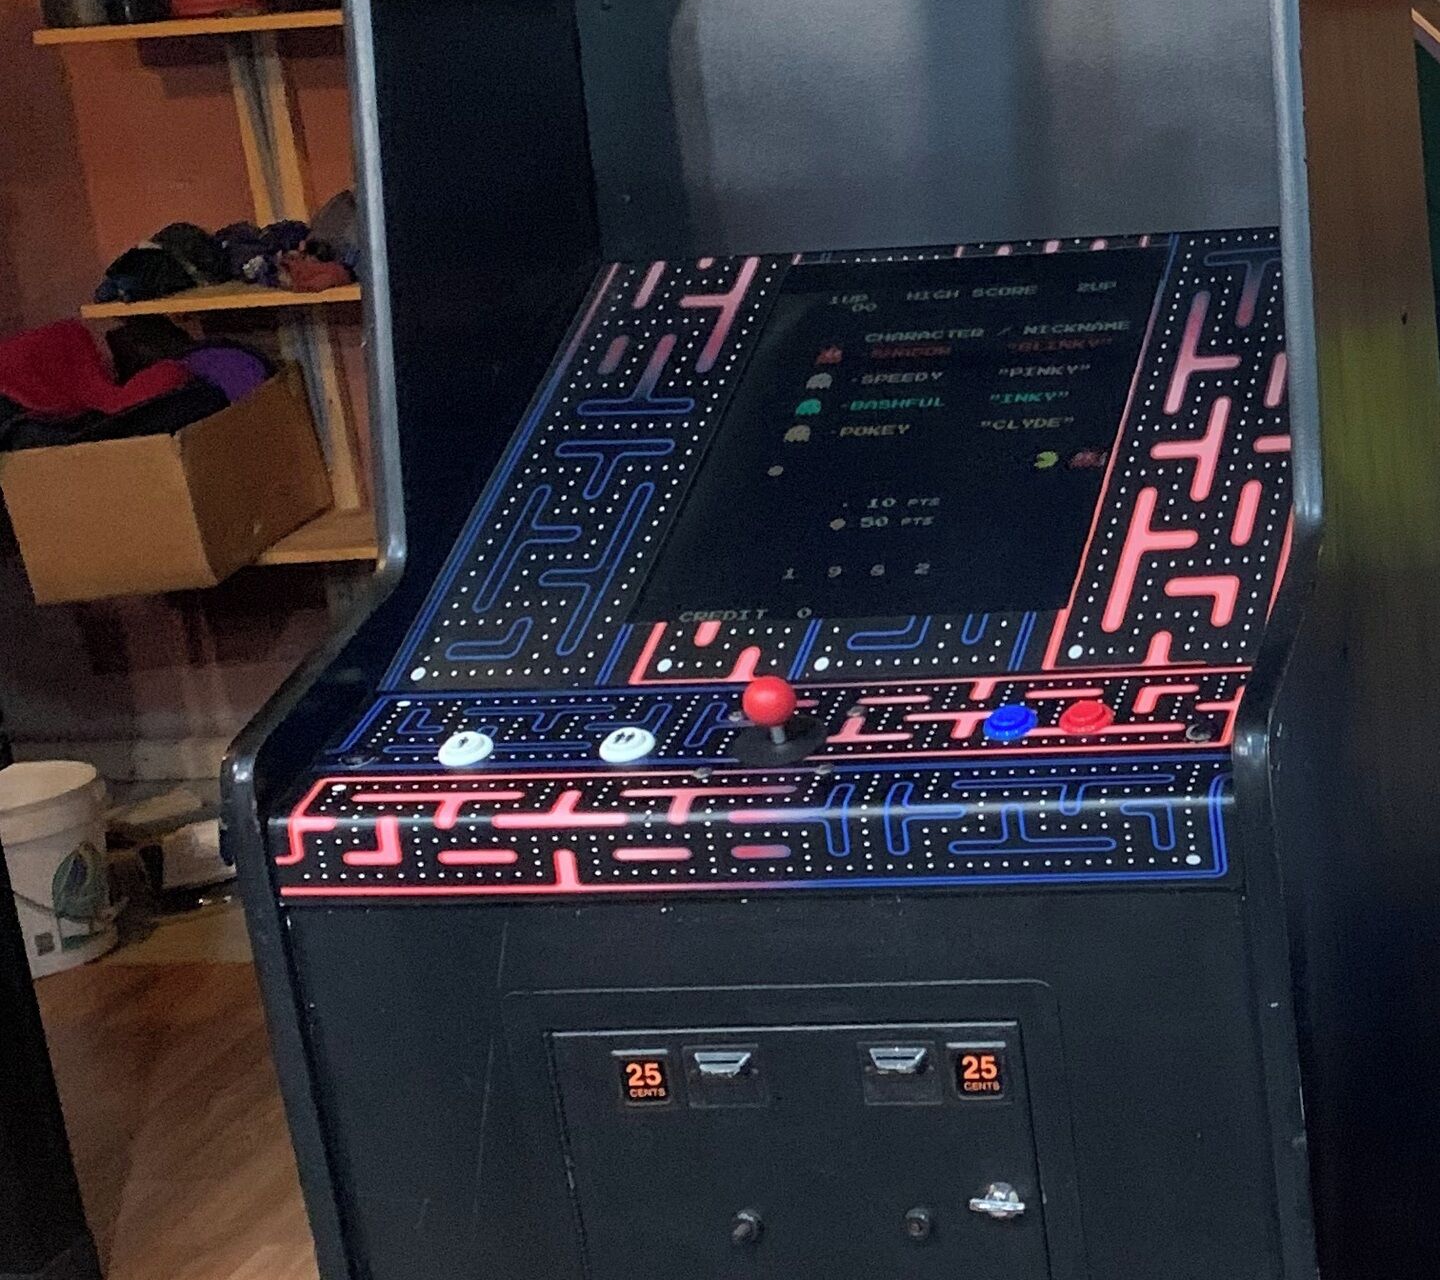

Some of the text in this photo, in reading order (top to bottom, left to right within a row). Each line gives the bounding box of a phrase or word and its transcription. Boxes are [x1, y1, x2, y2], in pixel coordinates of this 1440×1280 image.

[906, 289, 960, 302] HIGH
[971, 284, 1038, 298] SCORE
[865, 328, 985, 343] CHARACTER
[1022, 320, 1131, 335] NICKNAME
[866, 497, 896, 509] 10
[678, 607, 769, 623] CREDIT
[625, 1062, 662, 1087] 25
[961, 1055, 998, 1081] 25
[628, 1087, 667, 1099] CENTS
[963, 1080, 1001, 1092] CENTS
